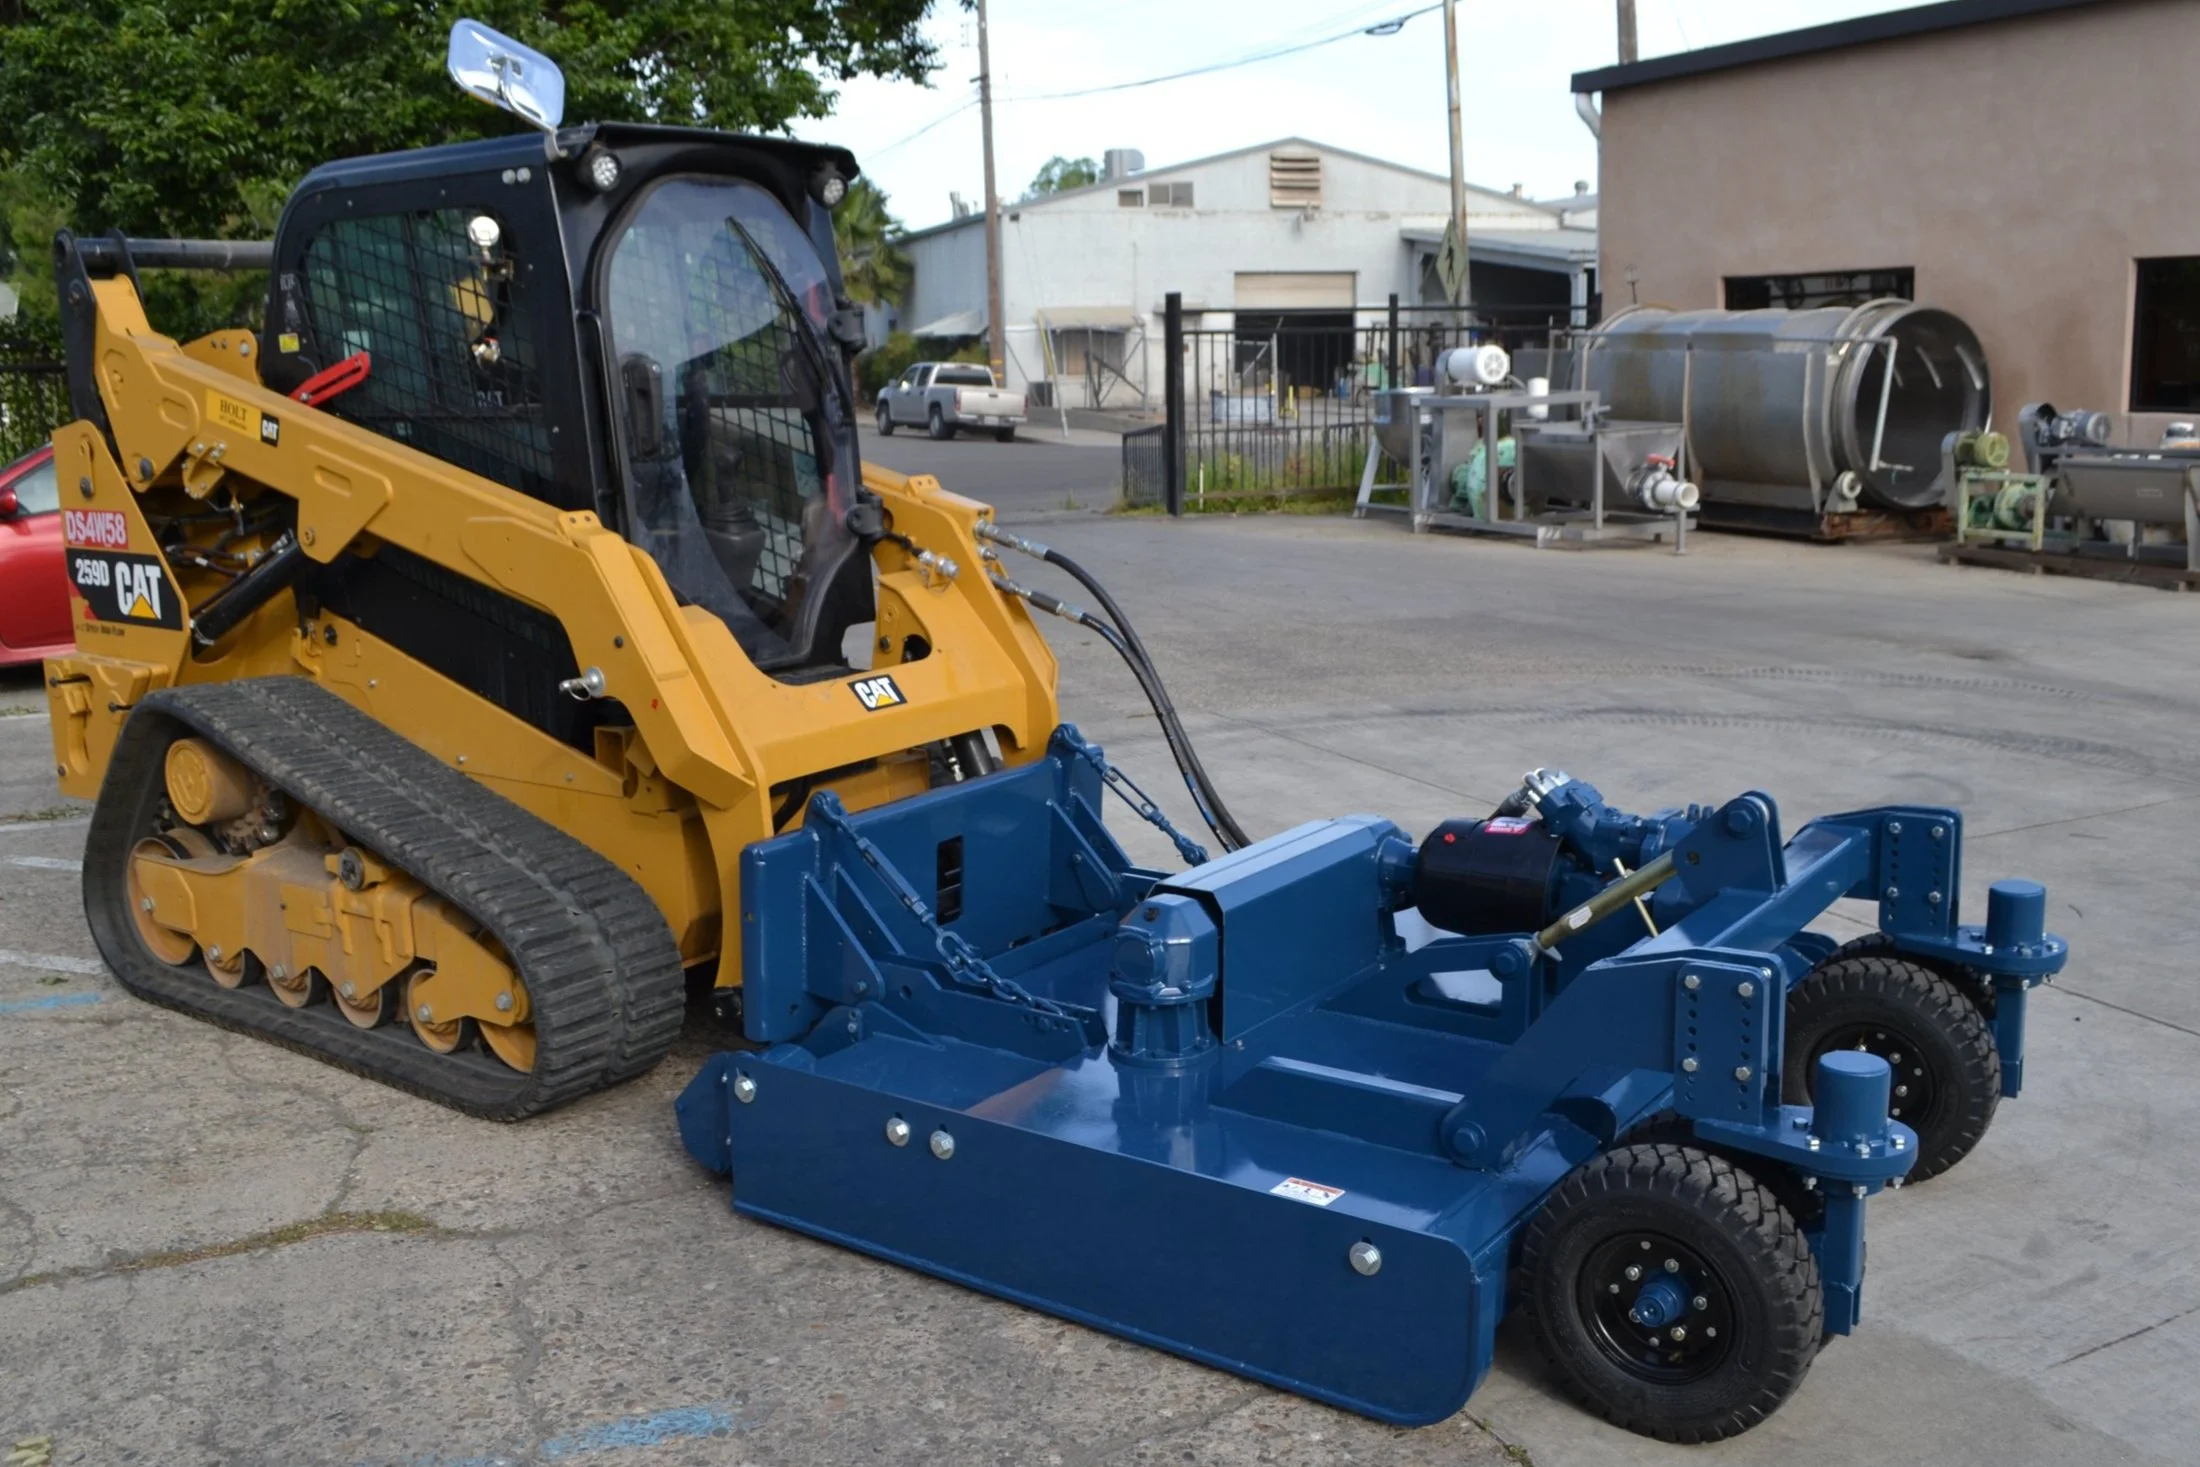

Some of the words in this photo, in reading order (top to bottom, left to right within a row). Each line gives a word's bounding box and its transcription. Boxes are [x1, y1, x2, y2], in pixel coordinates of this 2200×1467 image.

[220, 399, 248, 422] HOLT
[262, 418, 279, 441] CAT
[65, 510, 127, 545] DS4W58
[75, 558, 110, 587] 259D
[115, 561, 162, 621] CAT
[854, 677, 901, 708] CAT
